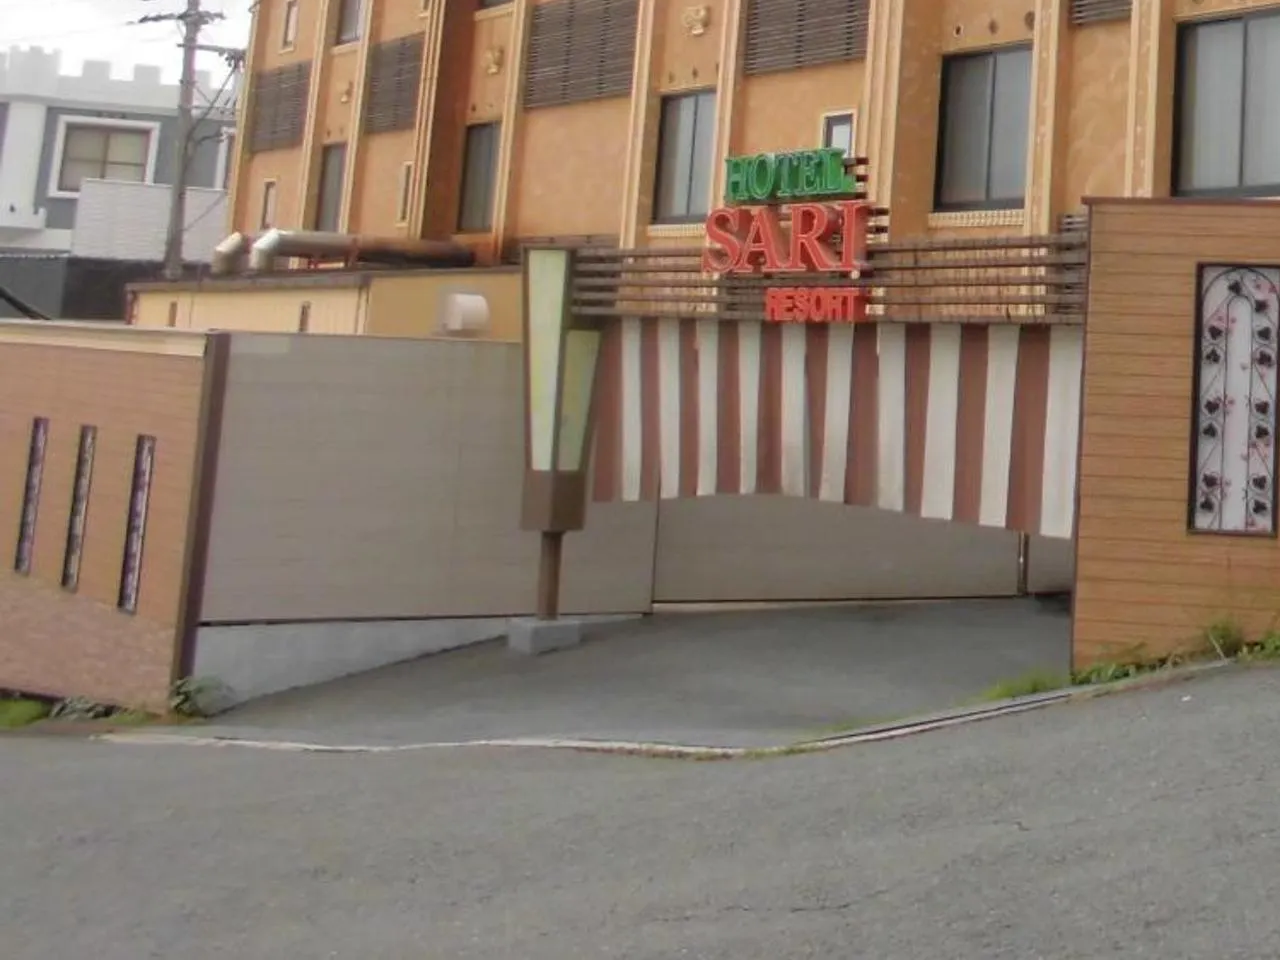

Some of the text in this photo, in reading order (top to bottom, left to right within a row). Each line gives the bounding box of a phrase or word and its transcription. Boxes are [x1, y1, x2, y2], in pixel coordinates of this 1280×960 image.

[725, 148, 853, 201] HOTEL
[703, 200, 868, 273] SARI
[764, 287, 862, 322] RESORT
